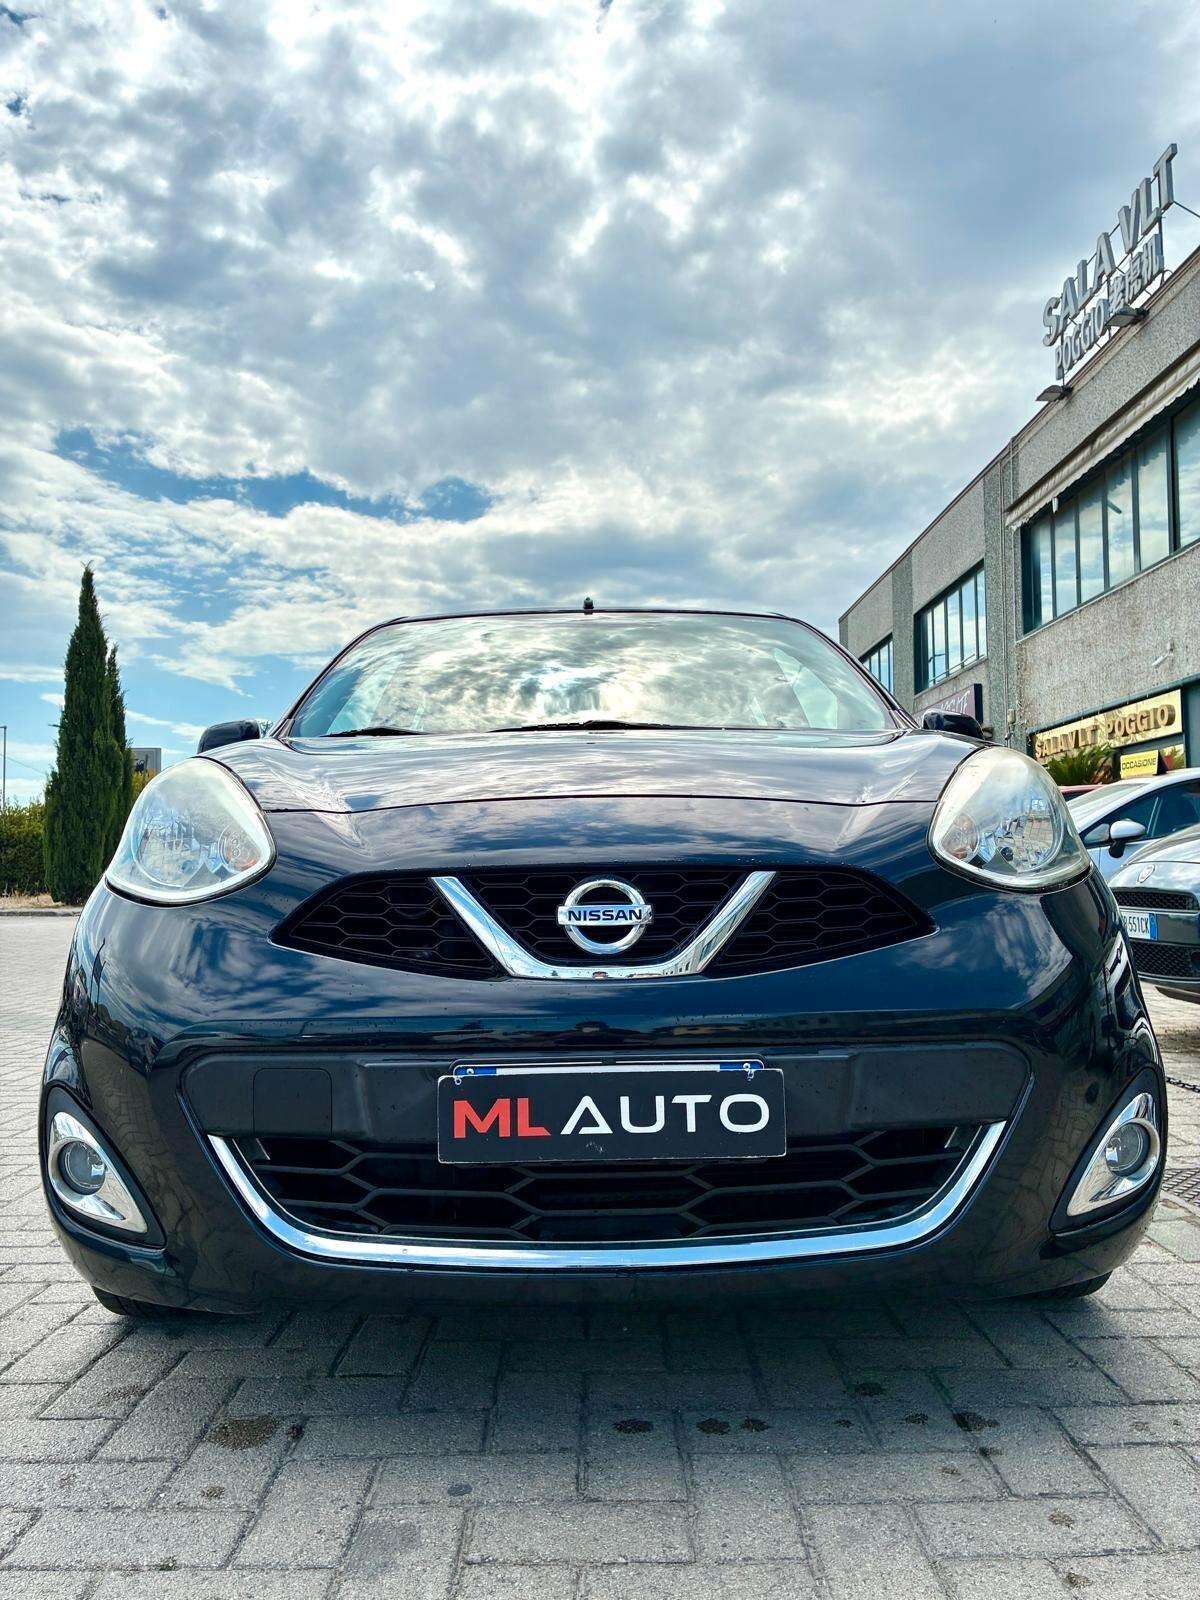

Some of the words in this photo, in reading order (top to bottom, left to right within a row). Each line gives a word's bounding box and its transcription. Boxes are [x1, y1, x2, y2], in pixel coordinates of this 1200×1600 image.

[1043, 232, 1116, 346] SALA
[1118, 143, 1177, 254] VLT
[1055, 298, 1110, 380] POGGIO
[1105, 704, 1175, 736] POGGIO
[1121, 757, 1156, 770] OCCASIONE
[567, 909, 642, 921] NISSAN
[453, 1098, 551, 1138] ML
[560, 1094, 770, 1135] AUTO
